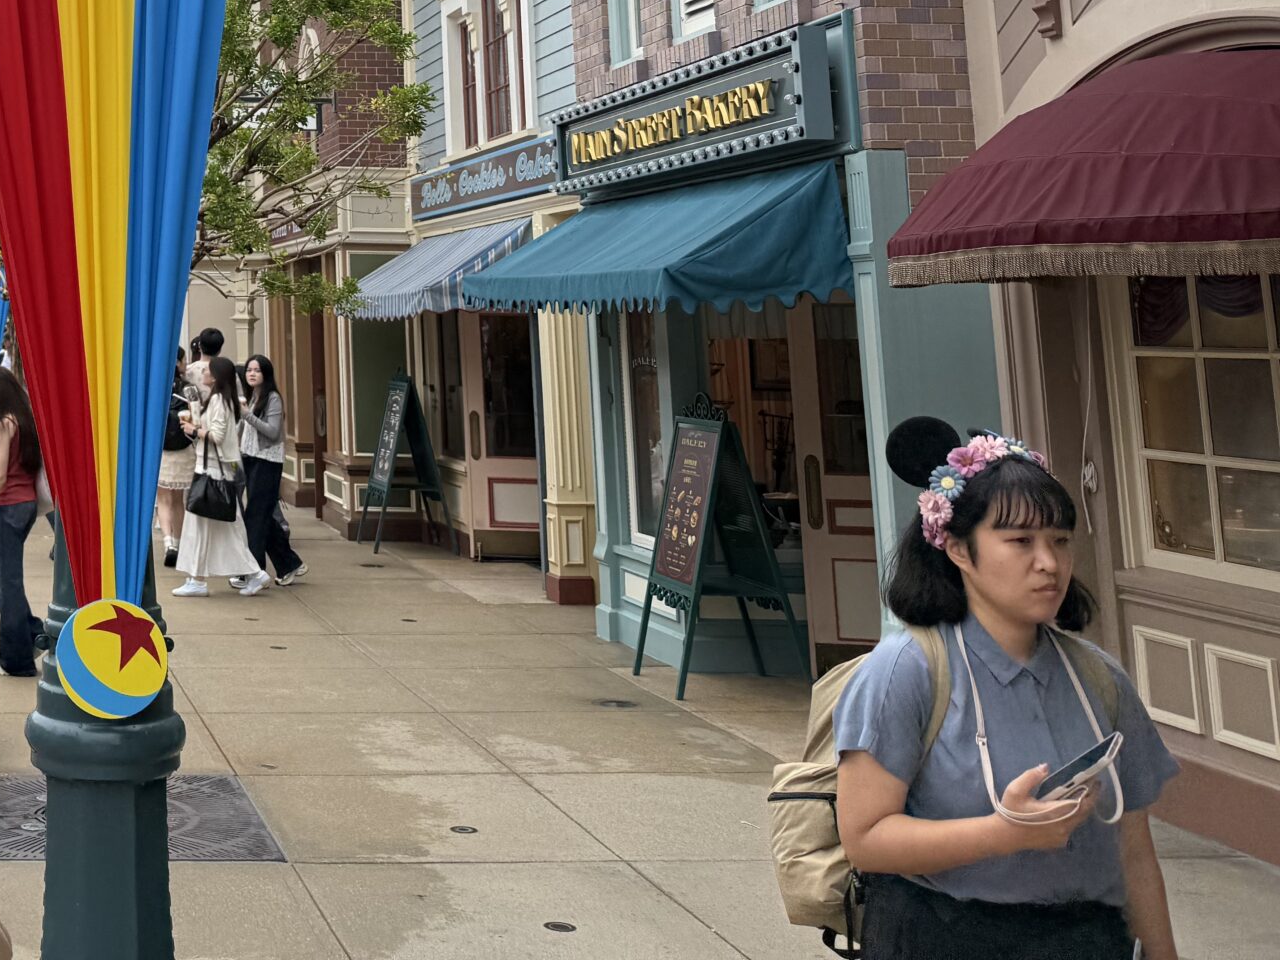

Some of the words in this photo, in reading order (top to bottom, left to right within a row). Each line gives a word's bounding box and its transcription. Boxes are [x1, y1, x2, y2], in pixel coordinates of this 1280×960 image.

[572, 128, 613, 165] MAIN
[613, 106, 681, 154] STREET
[685, 78, 773, 135] BAKERY
[458, 161, 507, 197] Cookies
